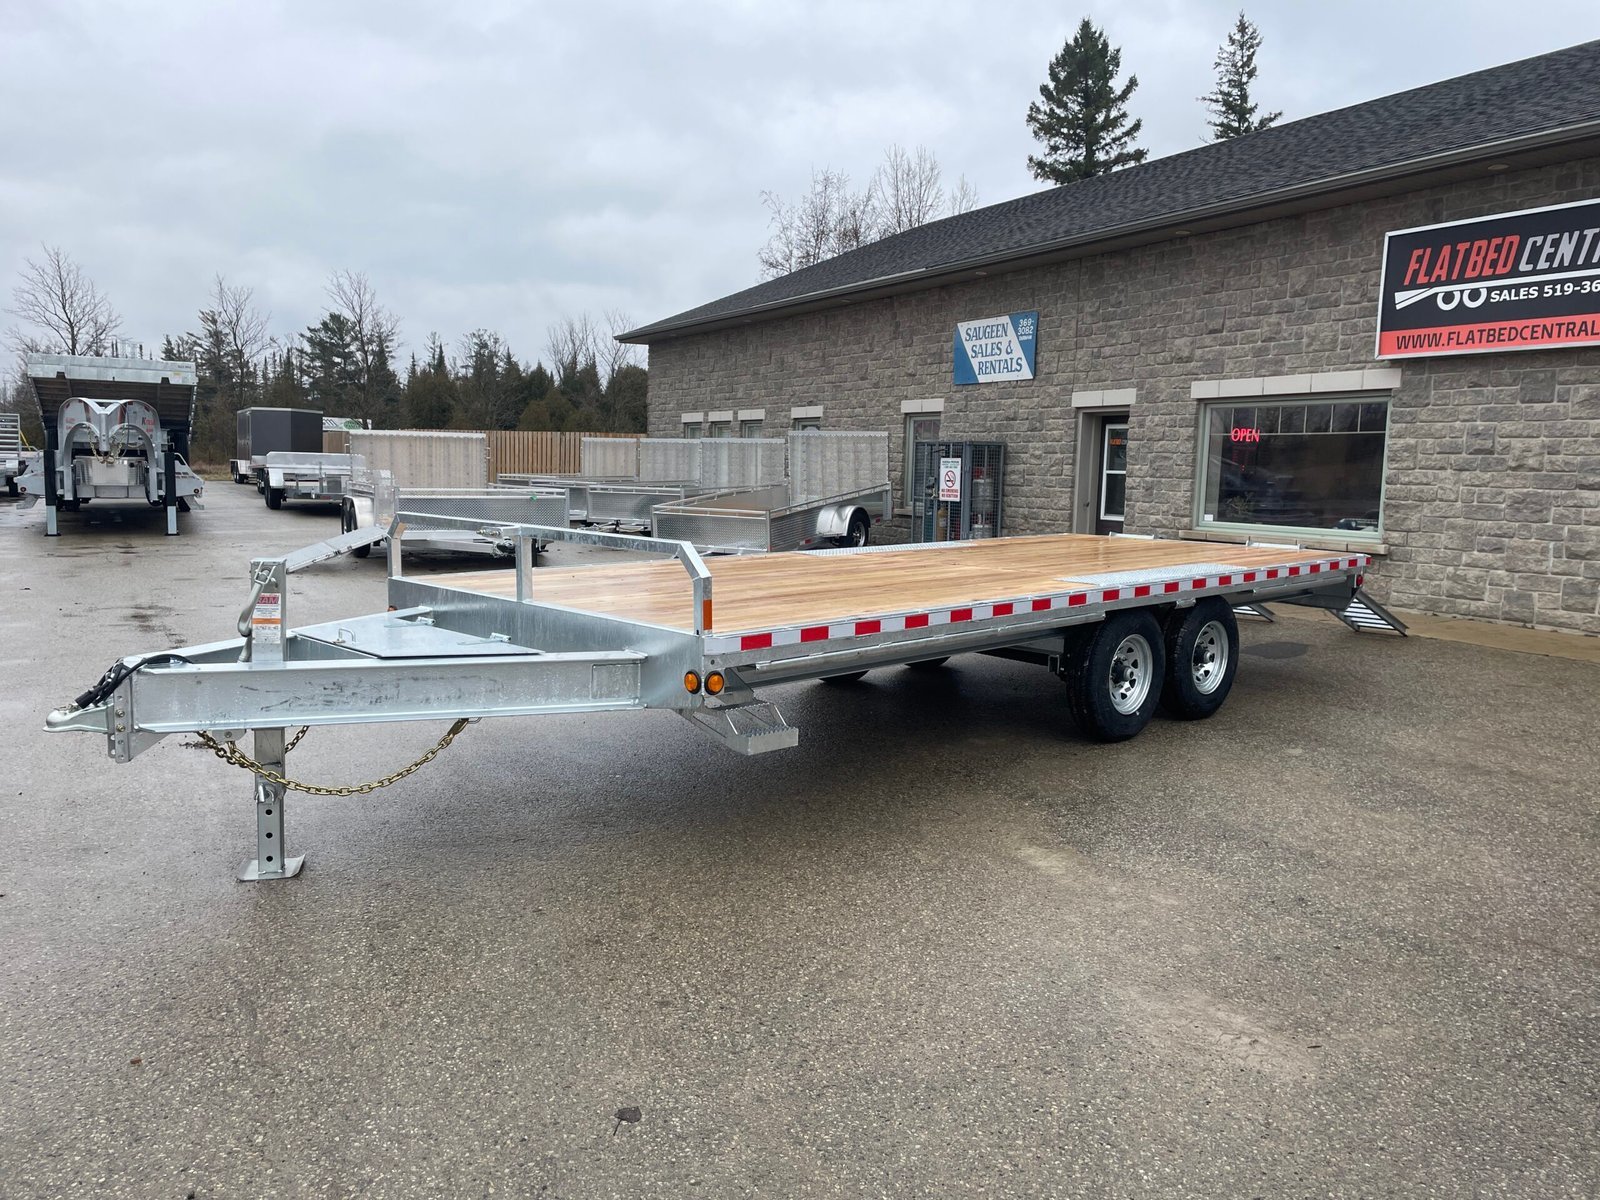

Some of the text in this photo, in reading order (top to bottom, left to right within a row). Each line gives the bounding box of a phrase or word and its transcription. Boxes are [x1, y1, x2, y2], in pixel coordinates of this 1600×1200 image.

[1404, 235, 1520, 286] FLATBED
[1490, 280, 1600, 302] SALES 519-36
[965, 323, 1008, 341] SAUGEEN
[1018, 326, 1033, 335] 3082
[971, 340, 1013, 358] SALES &
[978, 357, 1022, 375] RENTALS
[1231, 427, 1260, 442] OPEN
